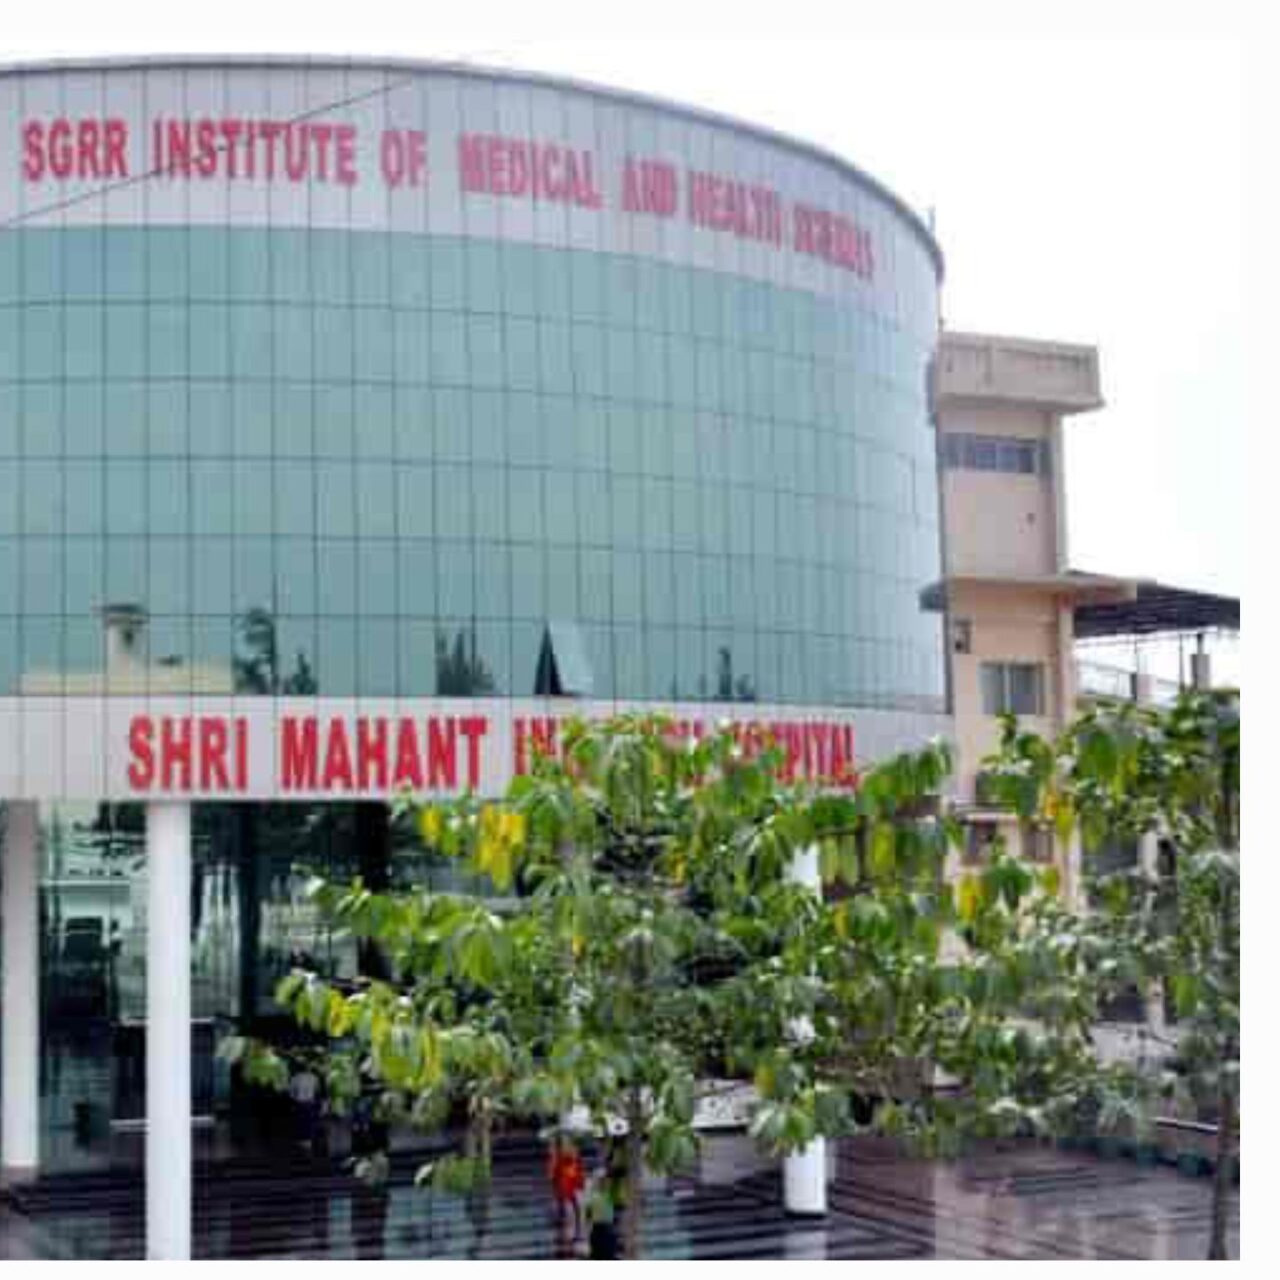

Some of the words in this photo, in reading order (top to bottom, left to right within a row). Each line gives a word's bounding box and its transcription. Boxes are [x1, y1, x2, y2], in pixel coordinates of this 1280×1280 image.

[23, 118, 128, 181] SGRR
[154, 118, 357, 183] INSTITUTE
[380, 128, 426, 188] OF
[458, 132, 603, 210] MEDICAL
[128, 715, 248, 791] SHRI
[281, 714, 489, 791] MAHANT
